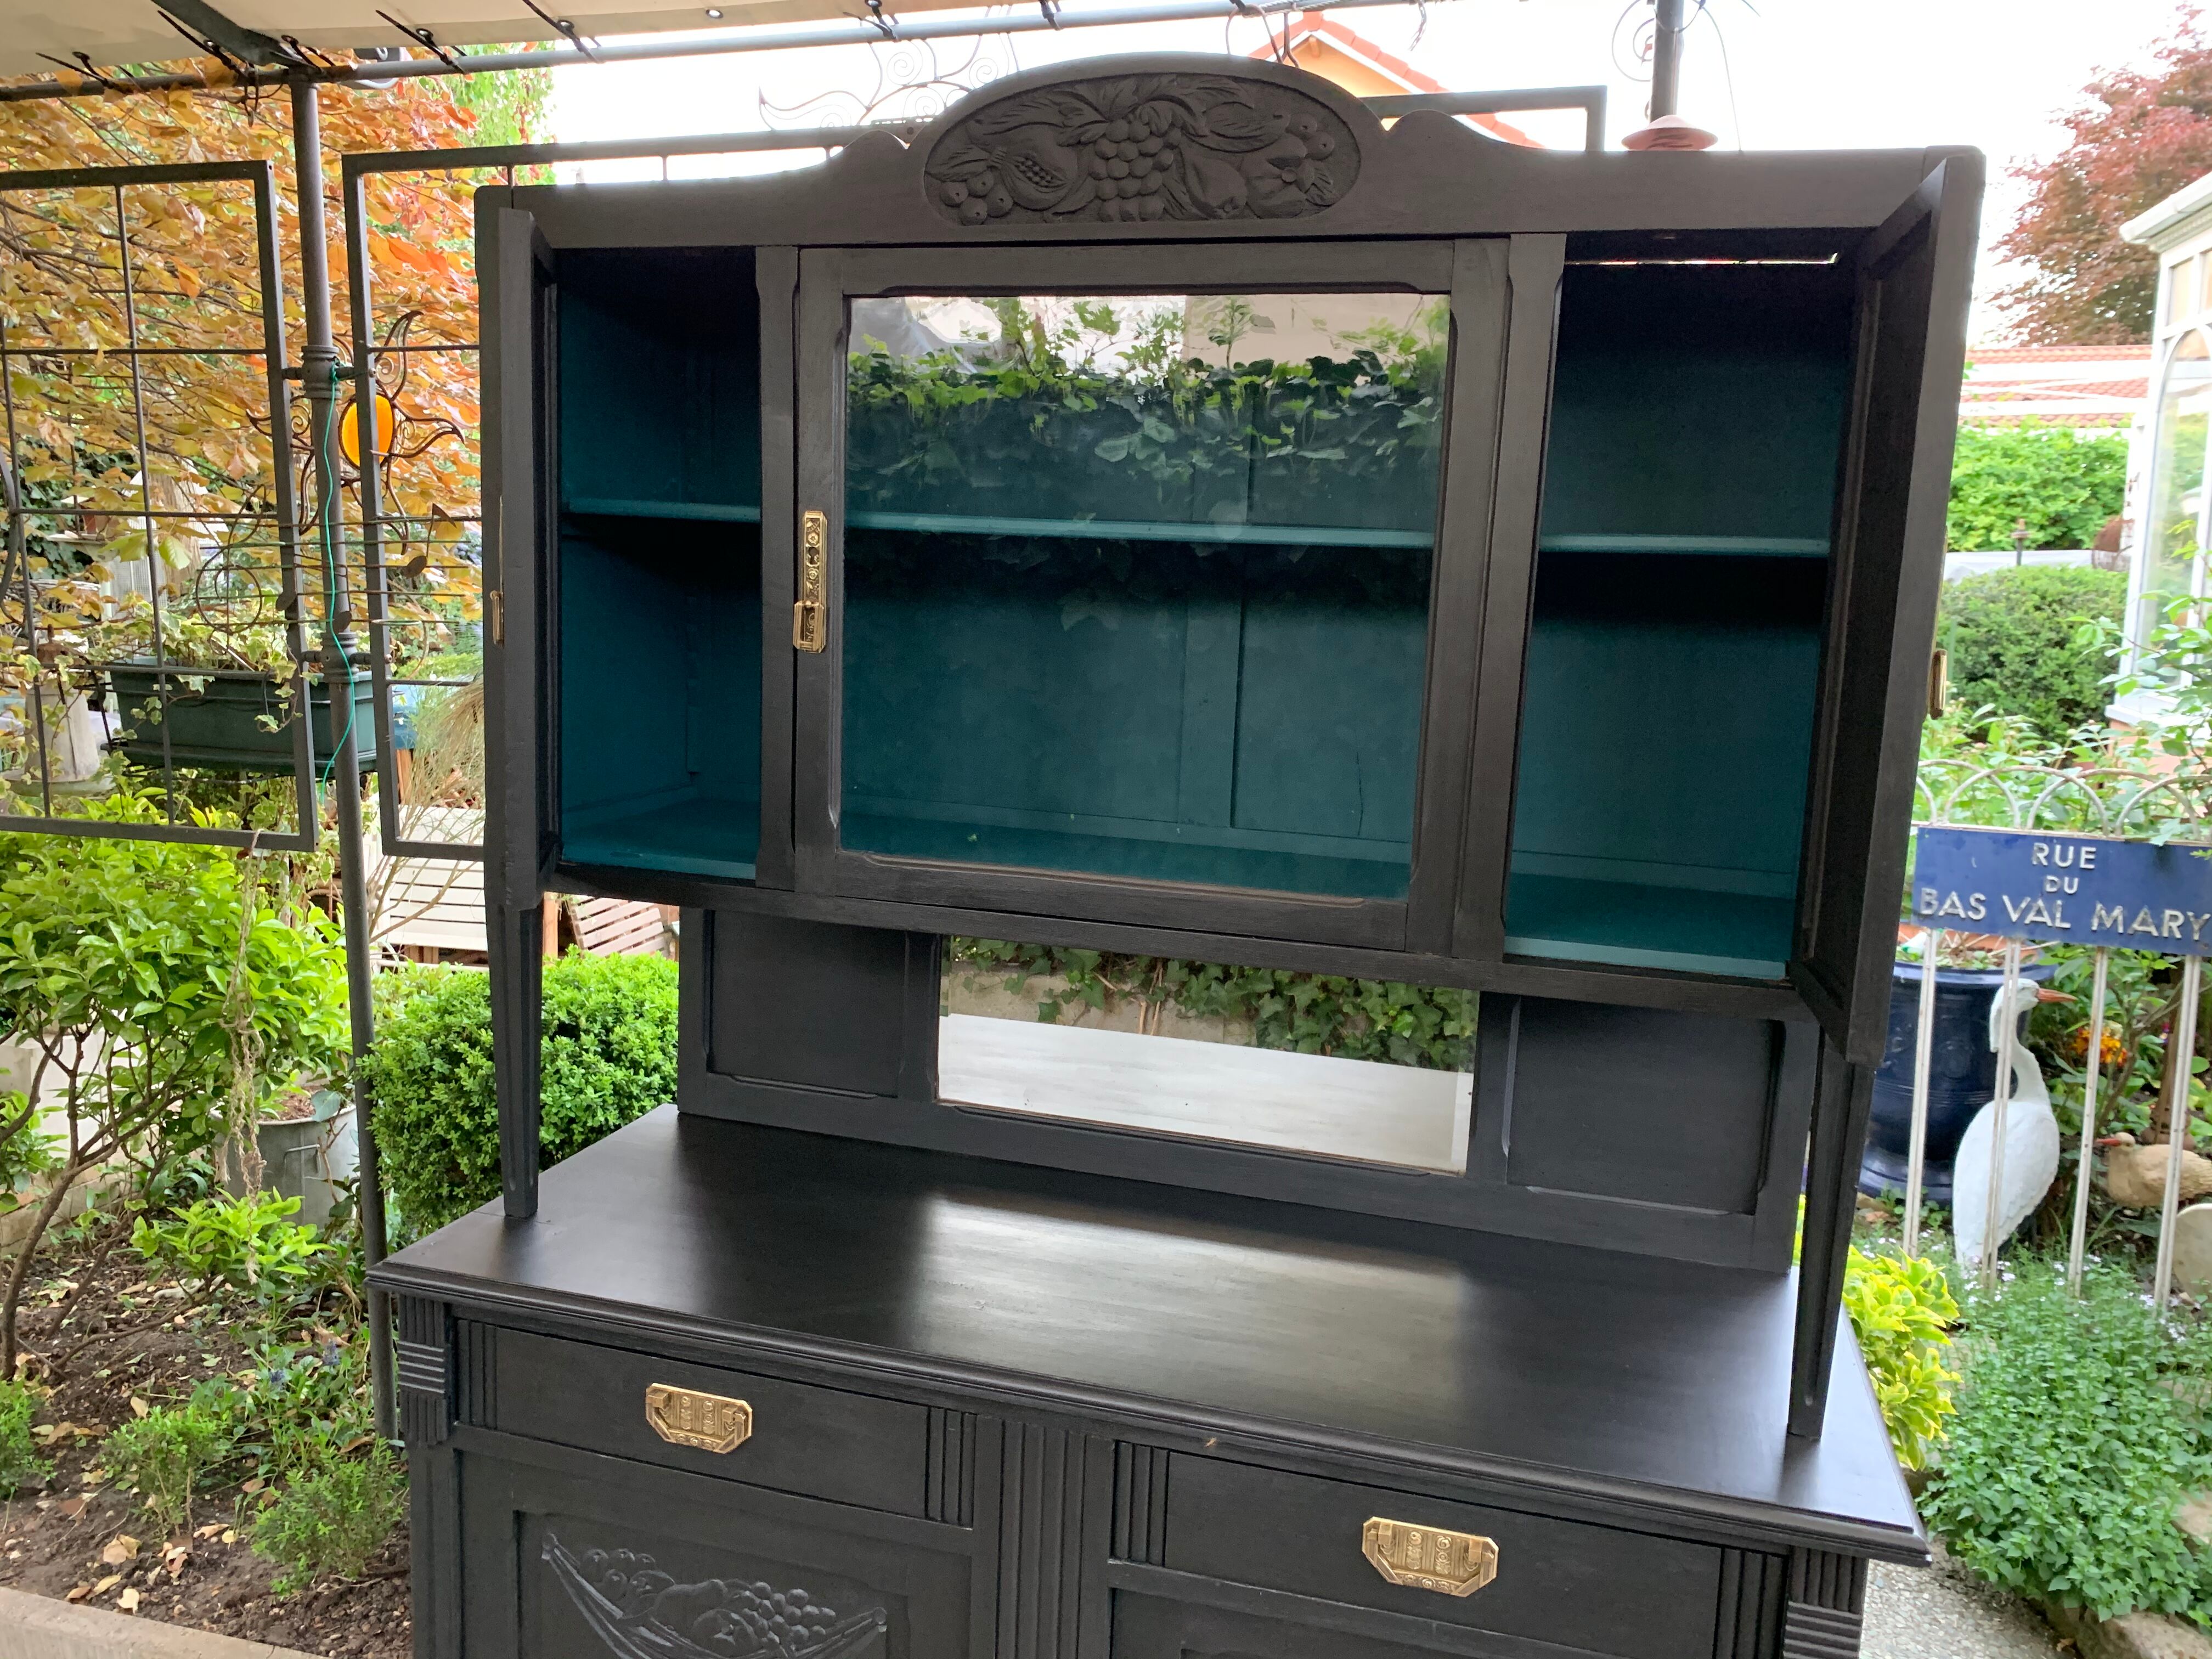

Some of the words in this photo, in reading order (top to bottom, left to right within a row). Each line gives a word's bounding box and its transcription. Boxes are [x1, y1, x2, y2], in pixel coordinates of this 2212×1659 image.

[2032, 842, 2096, 869] RUE
[2045, 875, 2079, 894] DU
[1920, 887, 1986, 921] BAS
[2002, 895, 2072, 929] VAL
[2091, 901, 2211, 940] MARY
